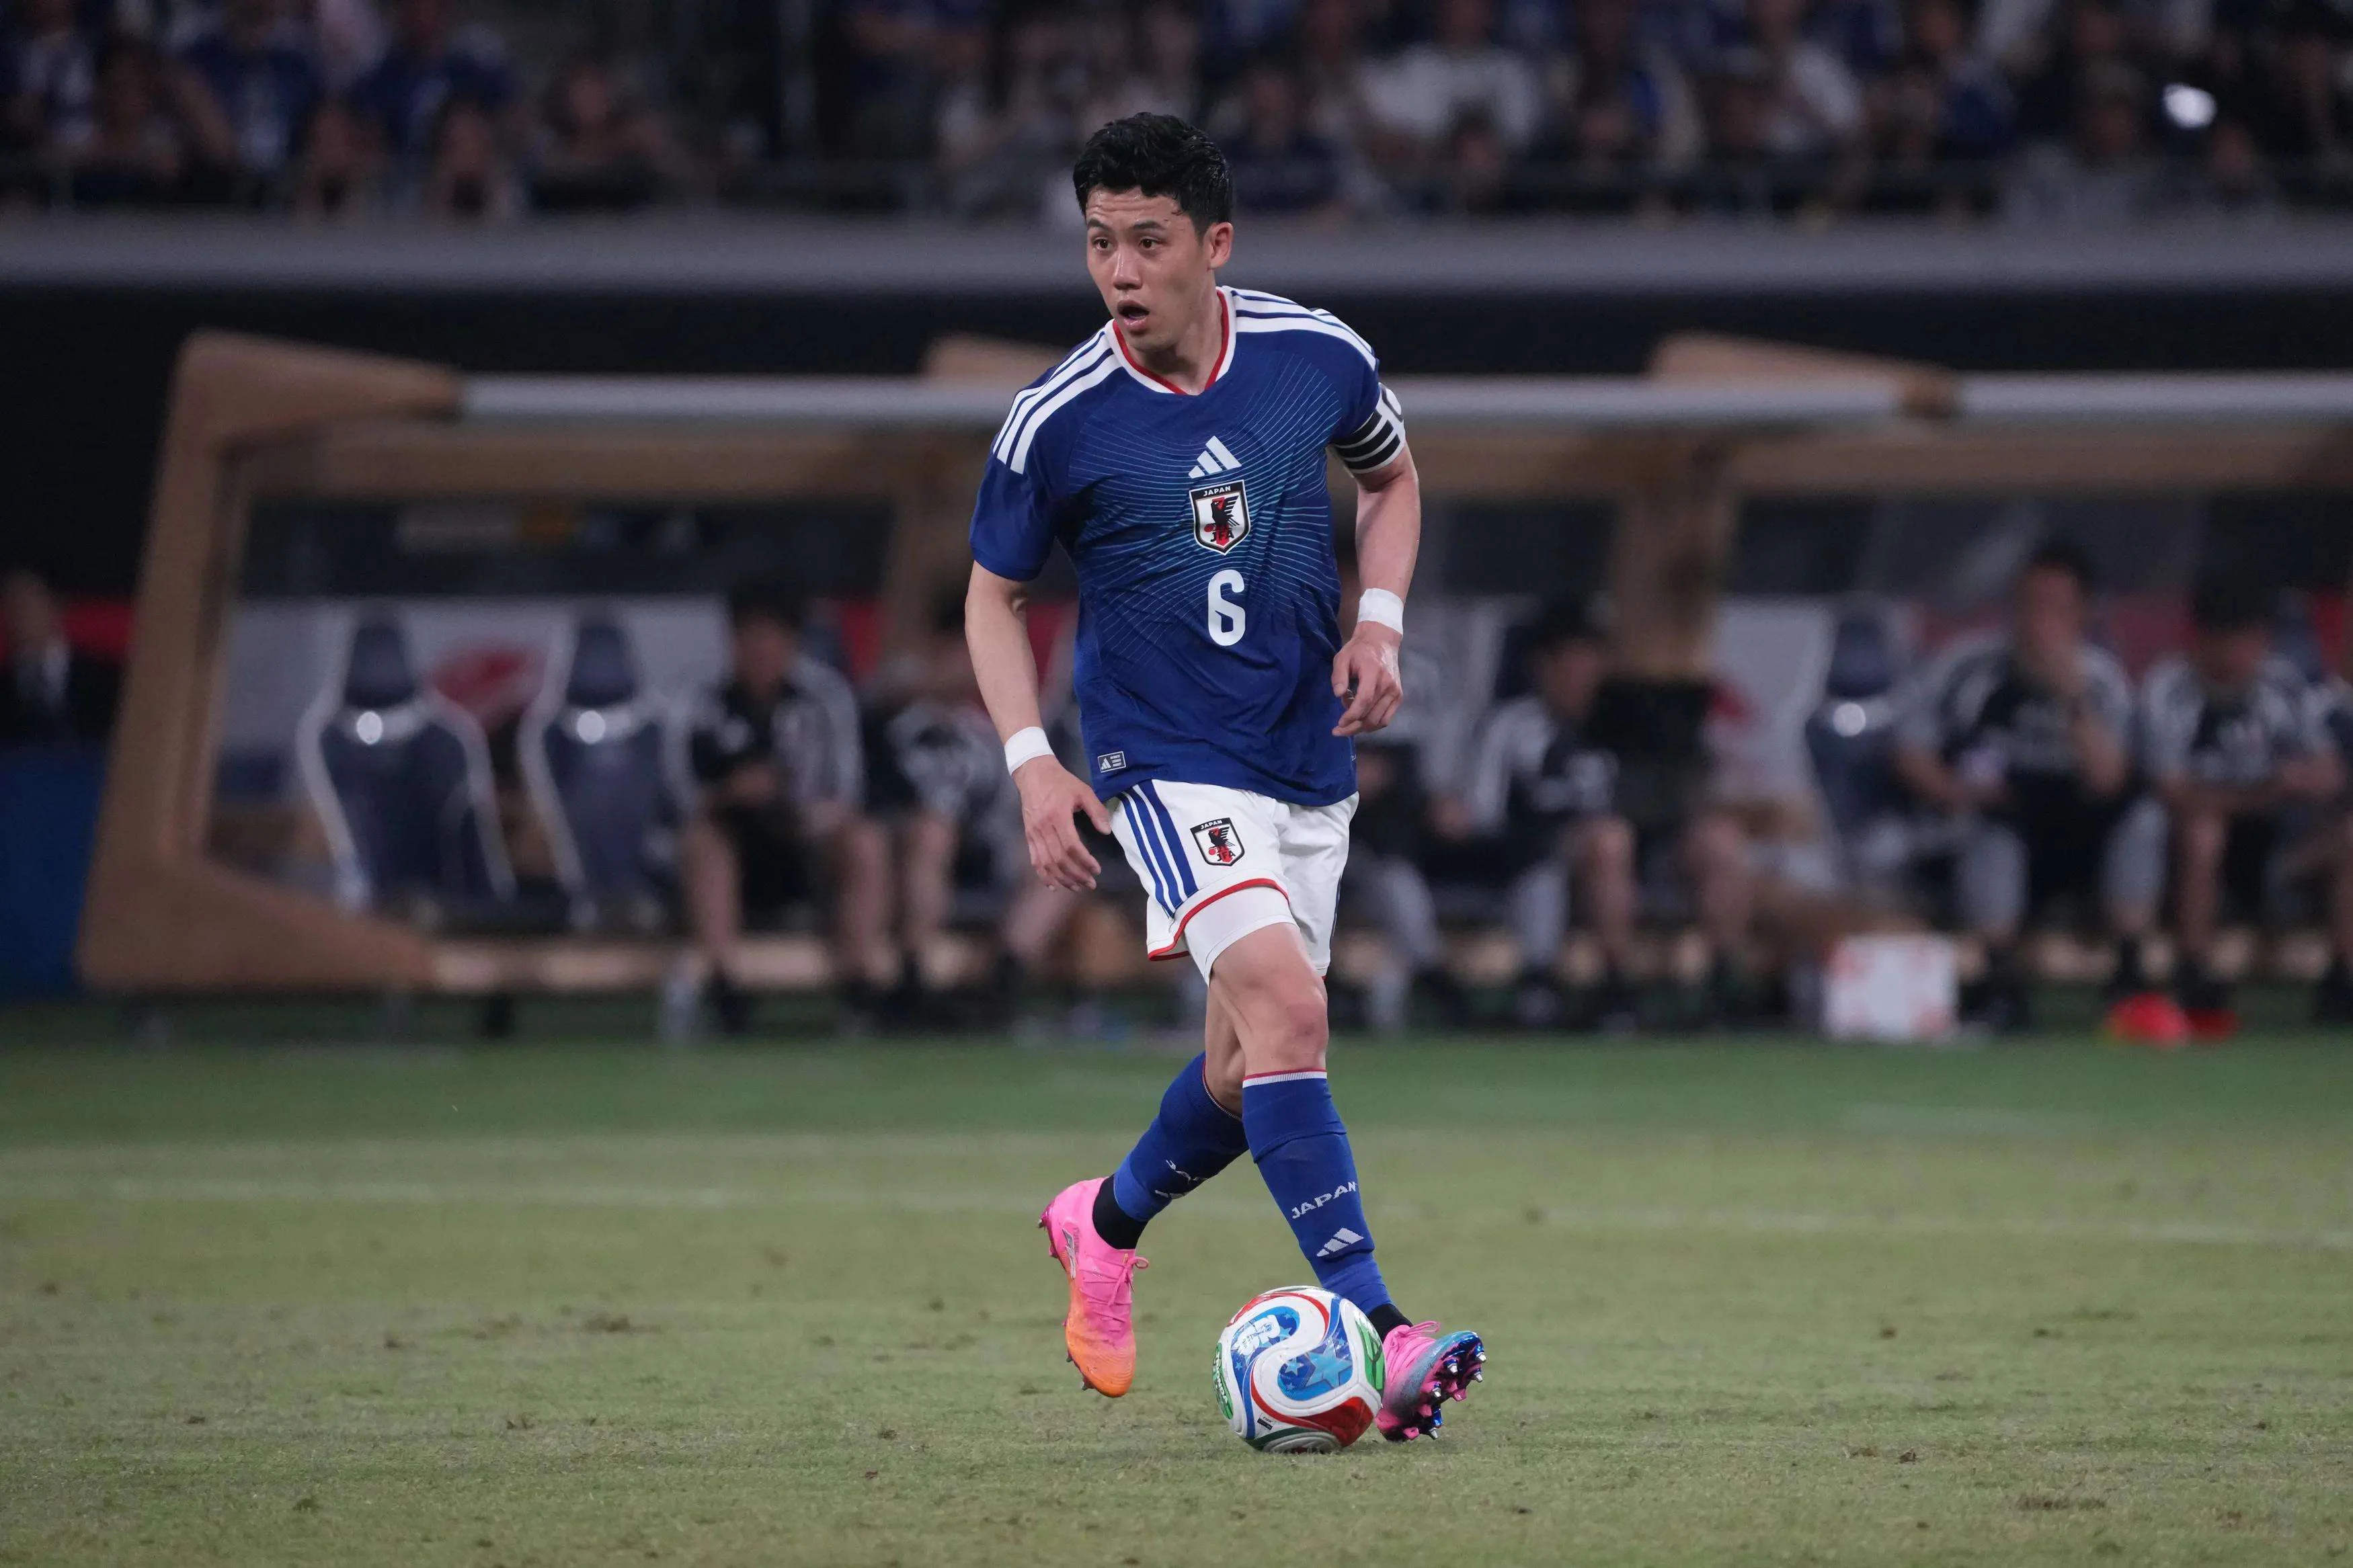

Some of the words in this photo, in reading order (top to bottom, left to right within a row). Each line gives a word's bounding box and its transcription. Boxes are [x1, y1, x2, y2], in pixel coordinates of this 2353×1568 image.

[1203, 485, 1231, 497] JAPAN
[1207, 569, 1246, 646] 6
[1200, 819, 1223, 830] JAPAN
[1291, 1182, 1356, 1219] JAPAN
